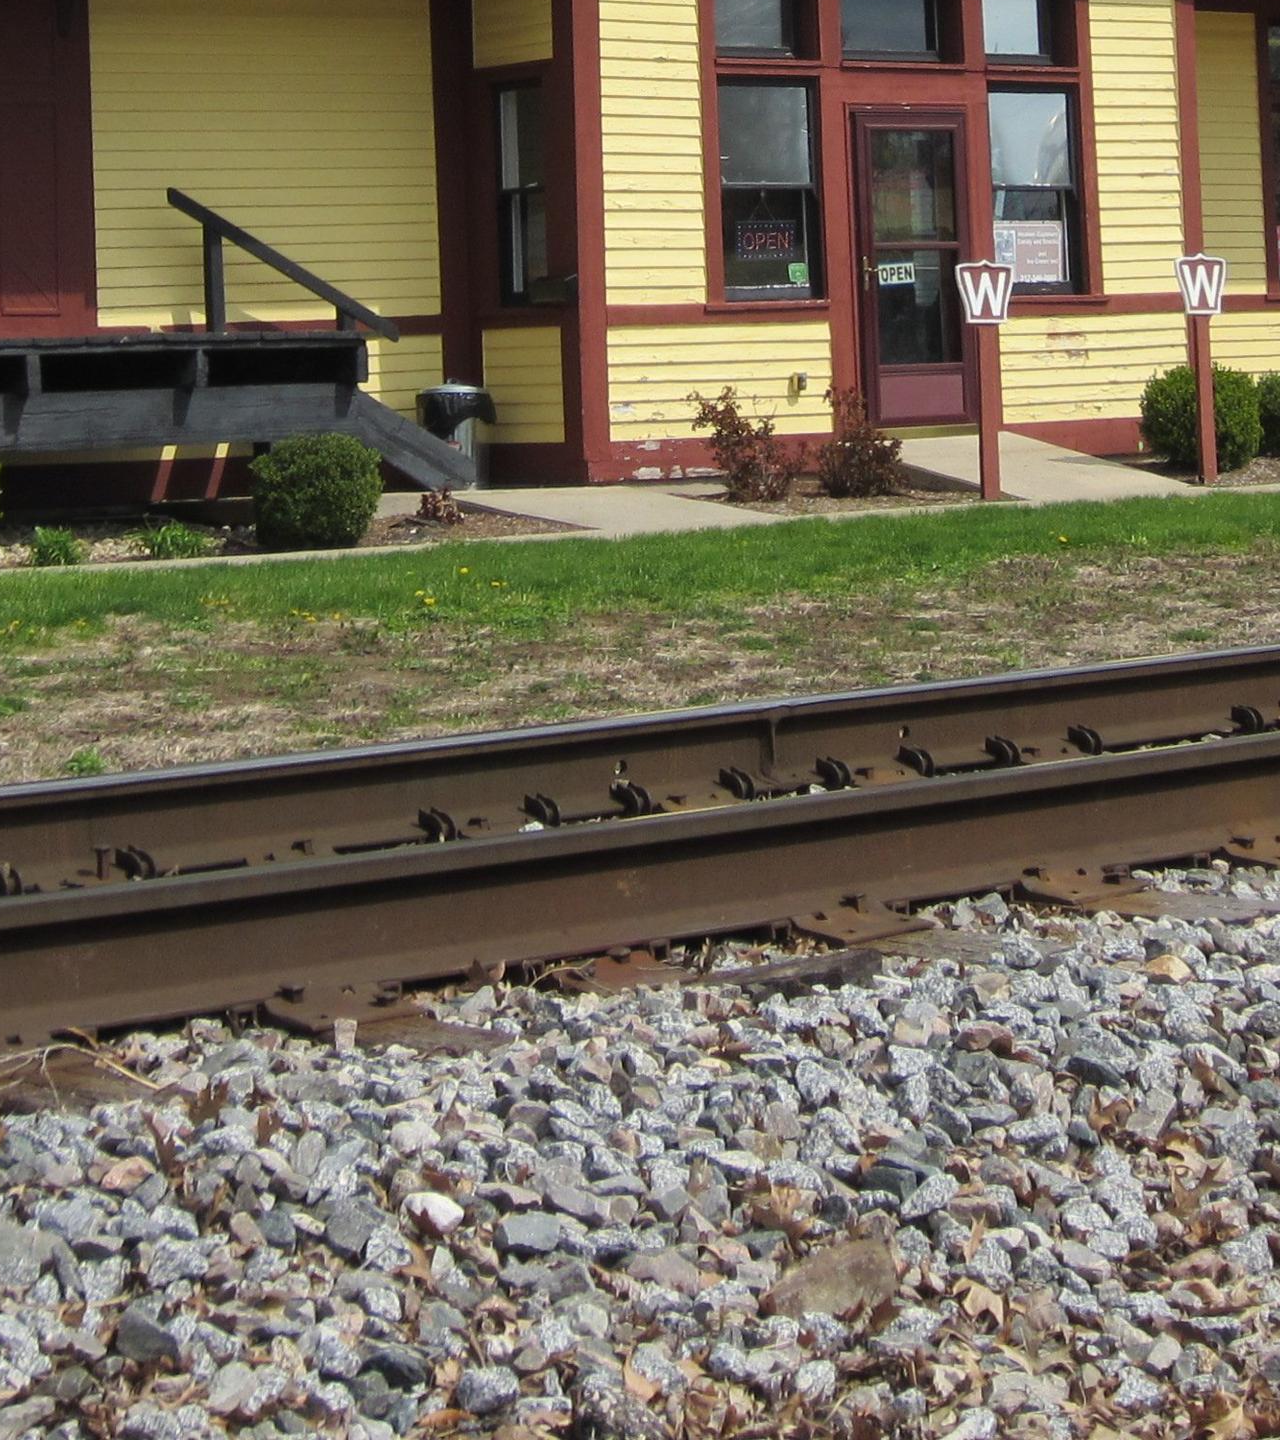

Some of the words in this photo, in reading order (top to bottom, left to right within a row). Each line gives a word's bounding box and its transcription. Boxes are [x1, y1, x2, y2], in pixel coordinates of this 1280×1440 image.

[742, 231, 790, 251] OPEN
[881, 264, 913, 283] OPEN
[1181, 265, 1220, 308] W
[963, 271, 1007, 317] W
